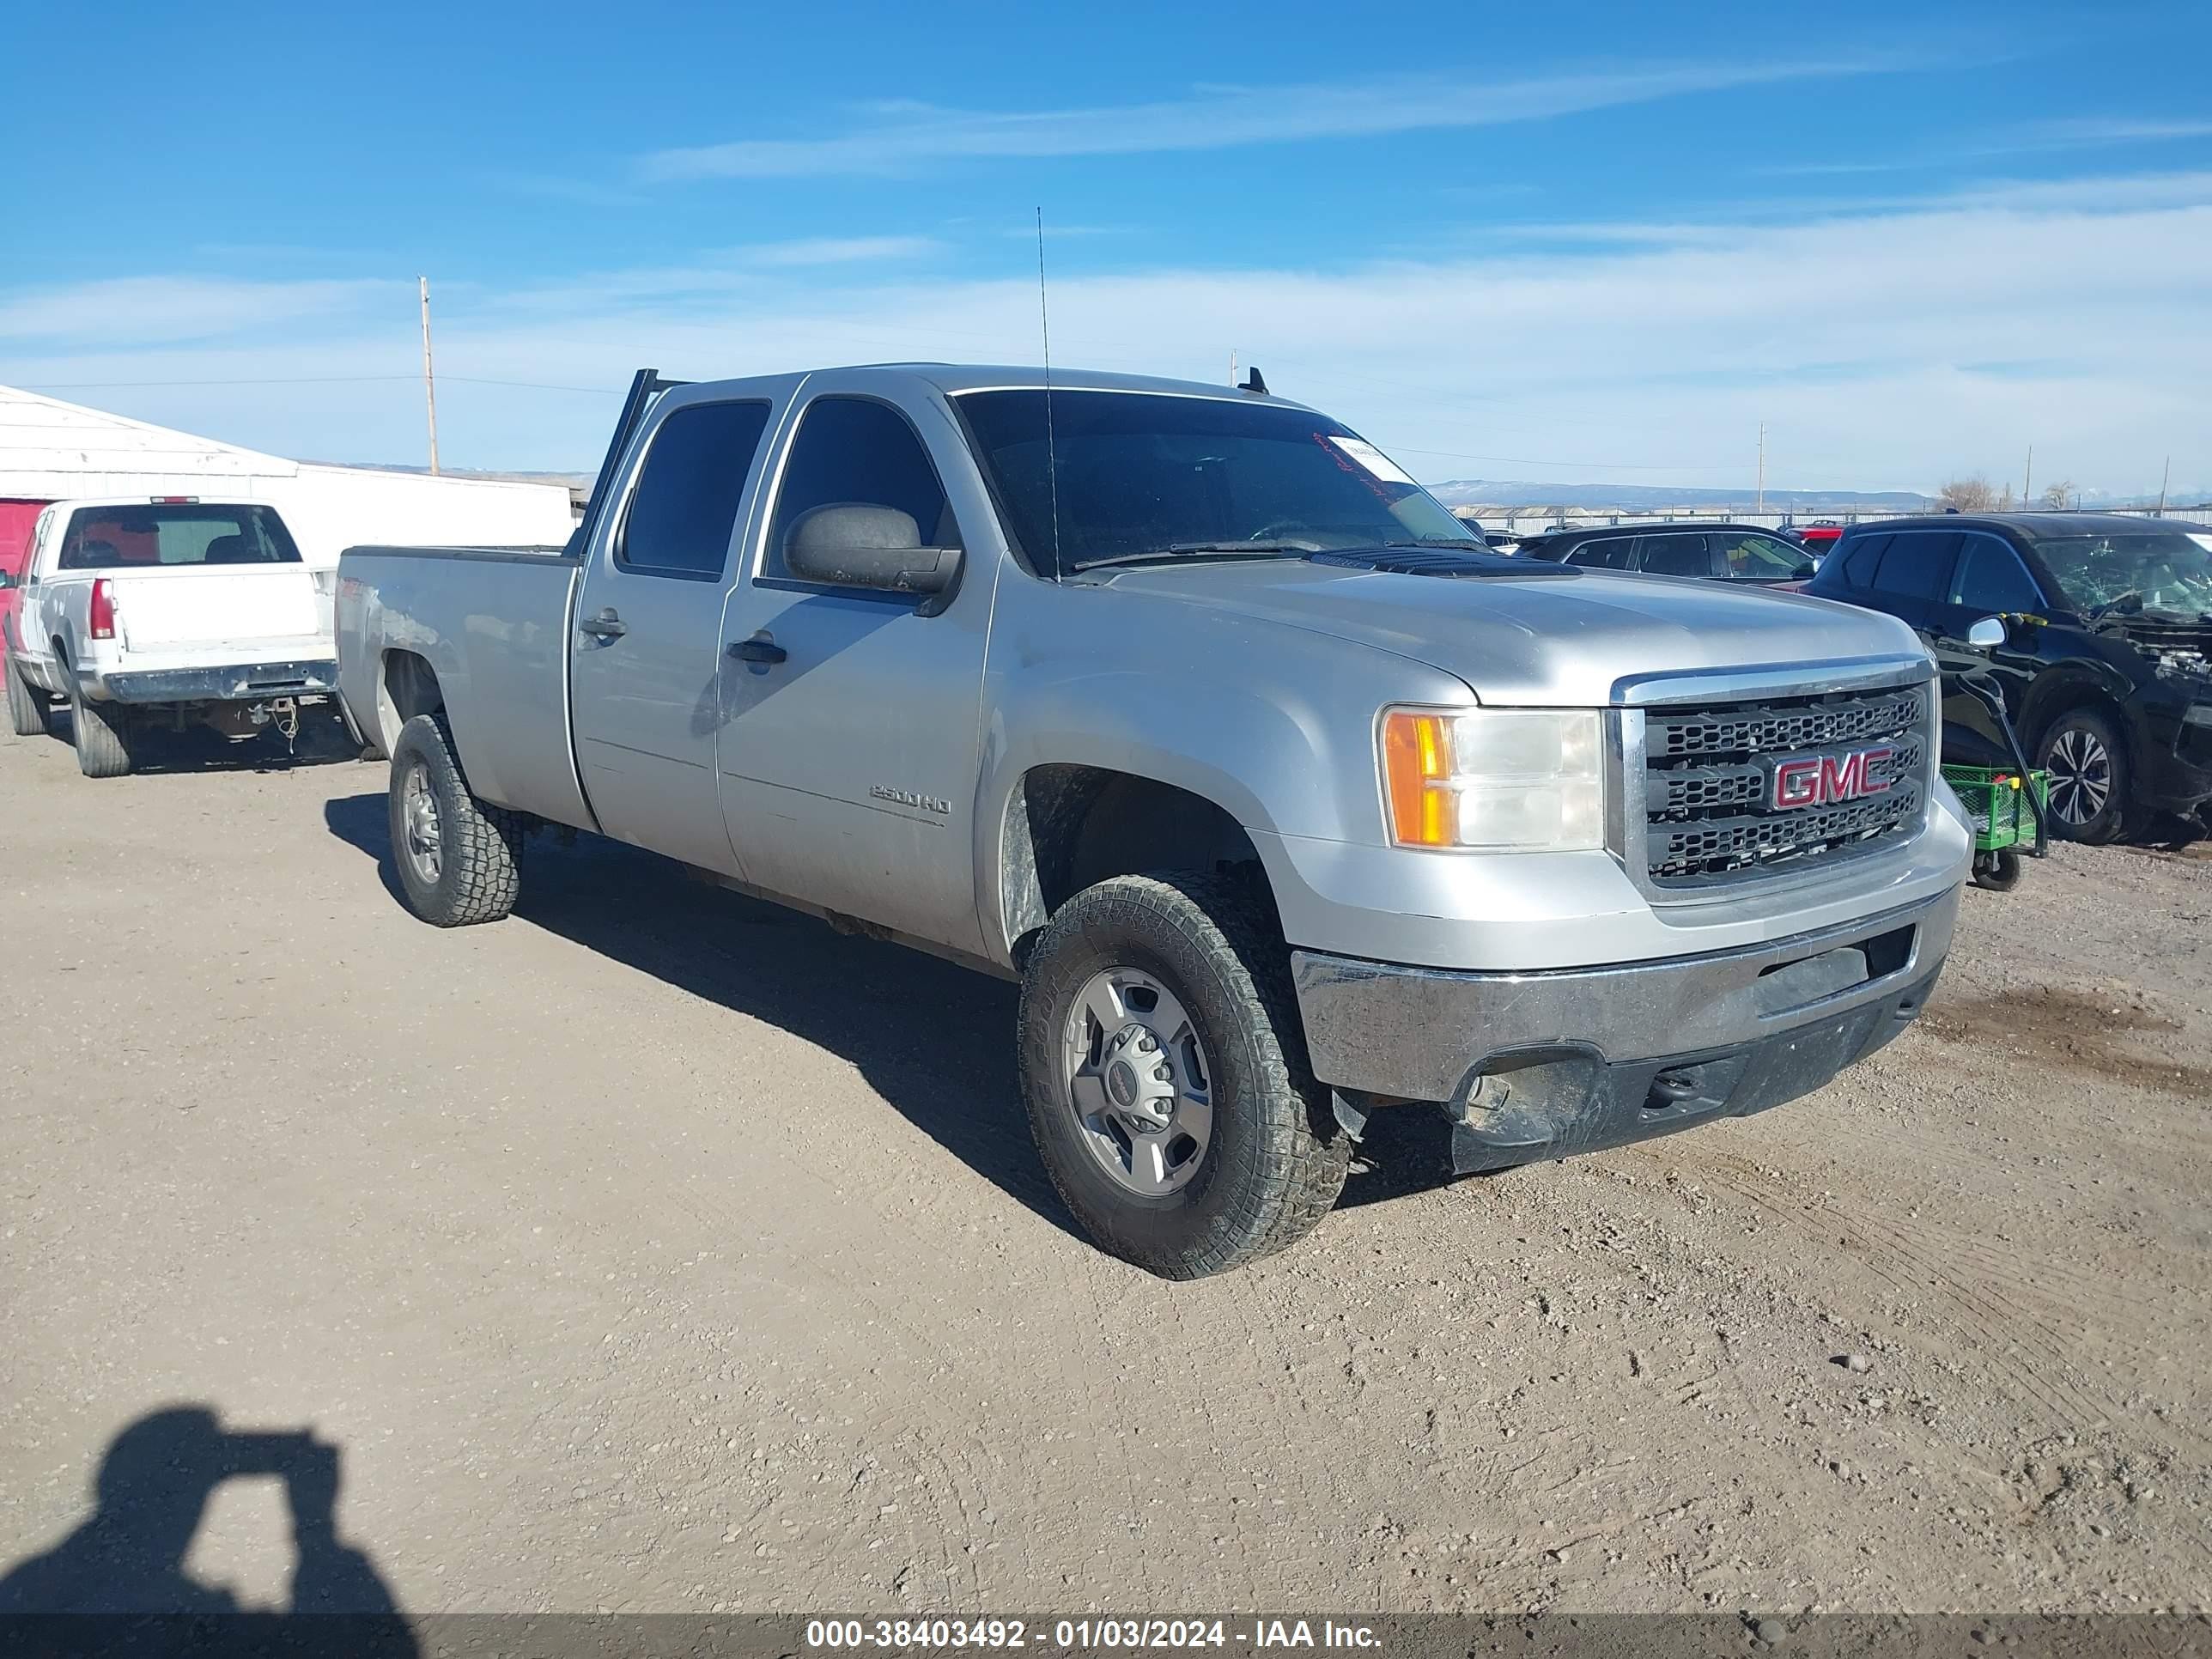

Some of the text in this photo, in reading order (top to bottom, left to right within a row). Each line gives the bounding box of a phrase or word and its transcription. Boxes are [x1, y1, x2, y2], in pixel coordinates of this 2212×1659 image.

[1772, 750, 1893, 811] GMC
[871, 785, 951, 815] 2500 HD
[1112, 1065, 1131, 1103] GMC
